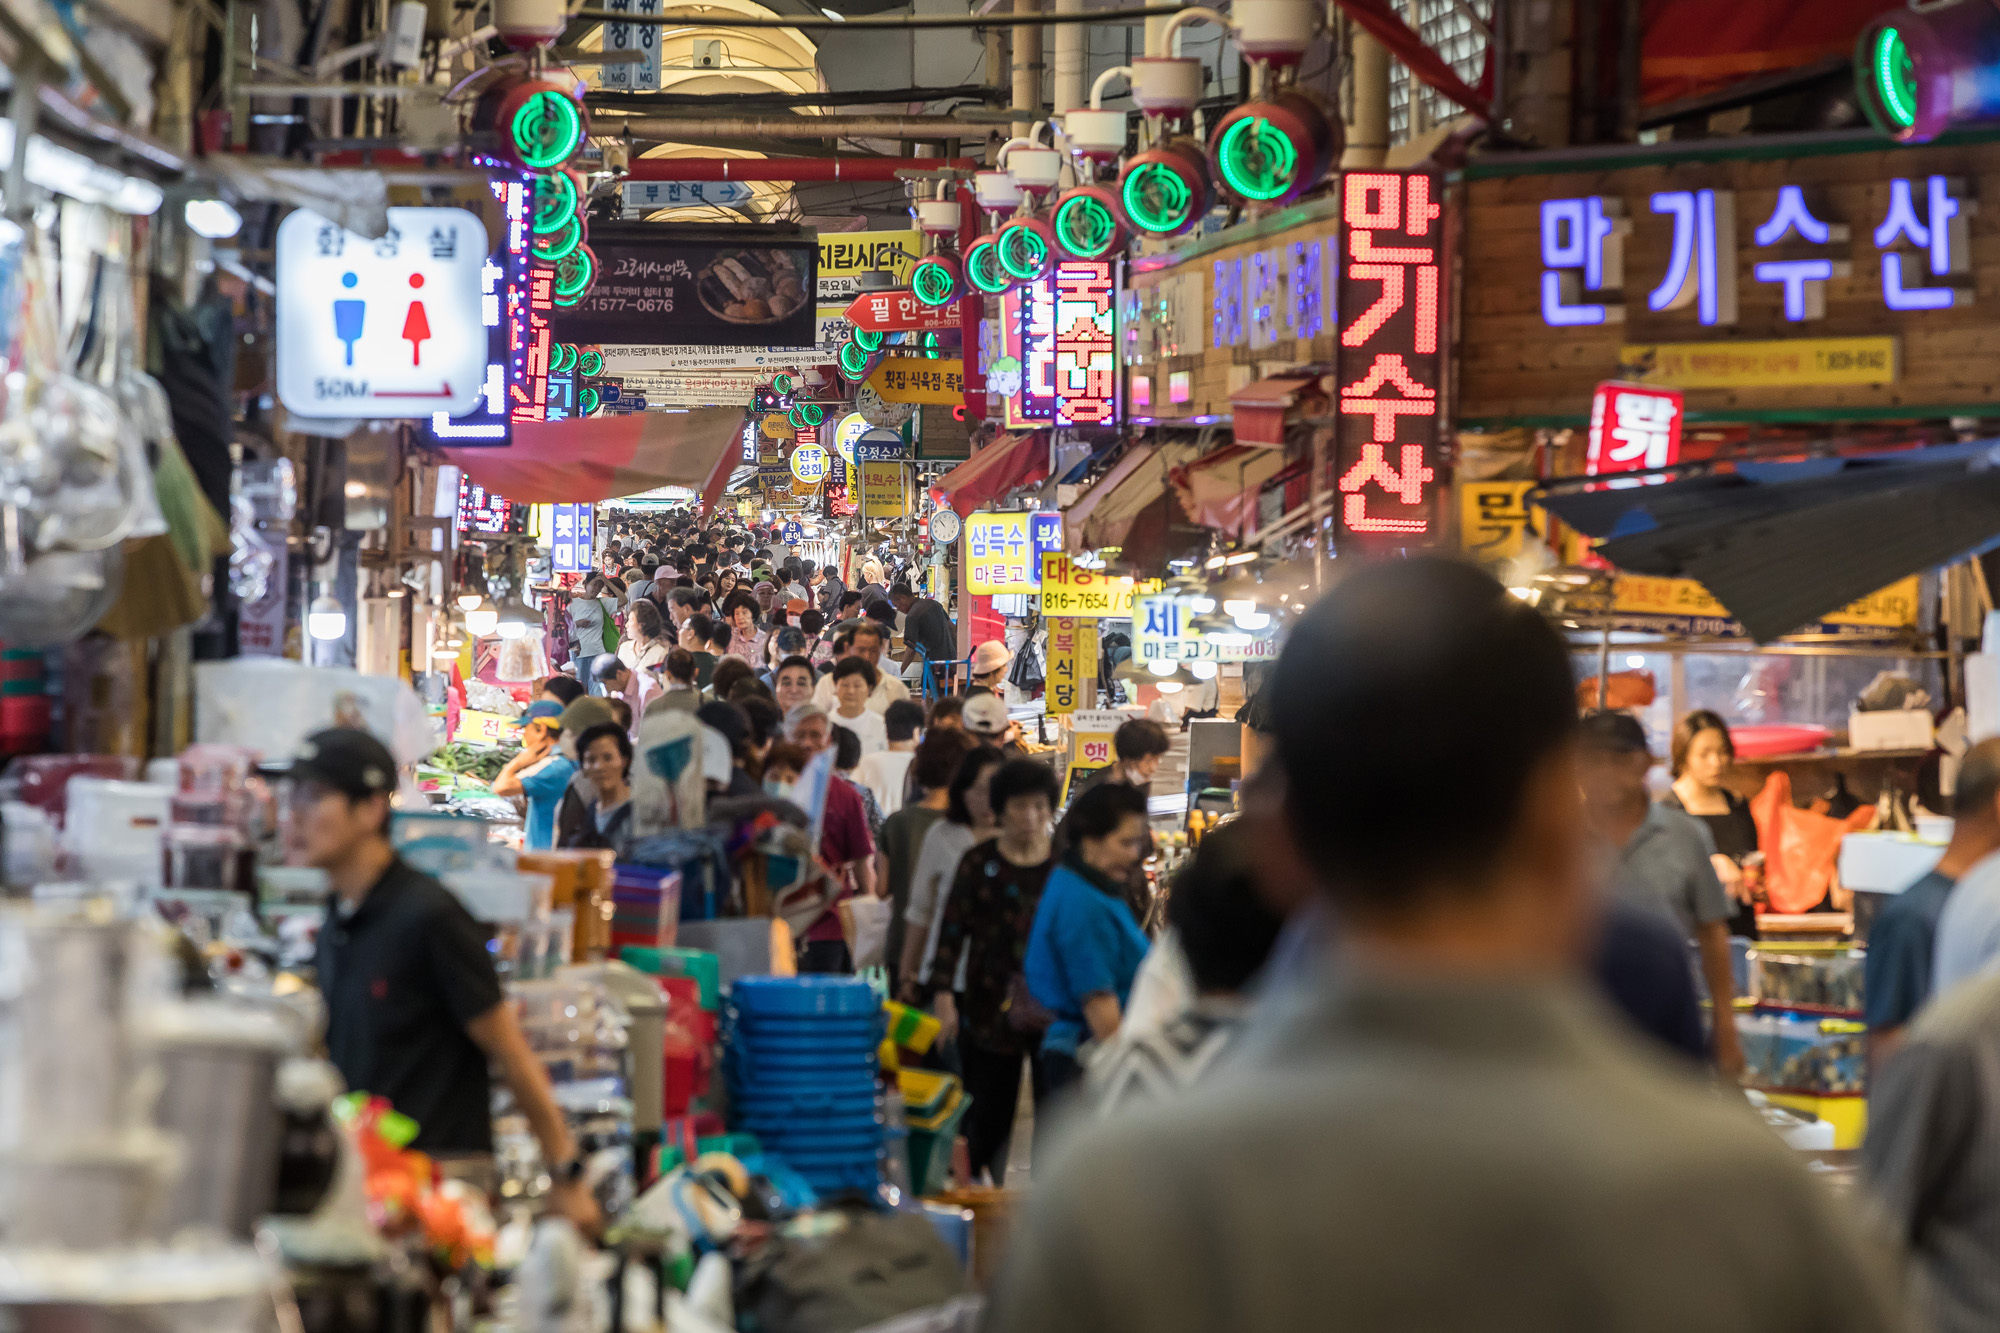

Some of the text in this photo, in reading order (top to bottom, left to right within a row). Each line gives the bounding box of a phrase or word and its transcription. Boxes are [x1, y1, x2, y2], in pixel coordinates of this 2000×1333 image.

[611, 72, 626, 83] MG
[640, 72, 653, 83] MG
[1541, 175, 1958, 326] 만기수산
[871, 298, 889, 322] 필
[1340, 174, 1439, 532] 만기수산
[798, 450, 822, 462] 진주
[799, 464, 822, 476] 상회
[788, 522, 797, 532] 산
[784, 532, 801, 541] 문어
[1045, 593, 1108, 609] 816-7654
